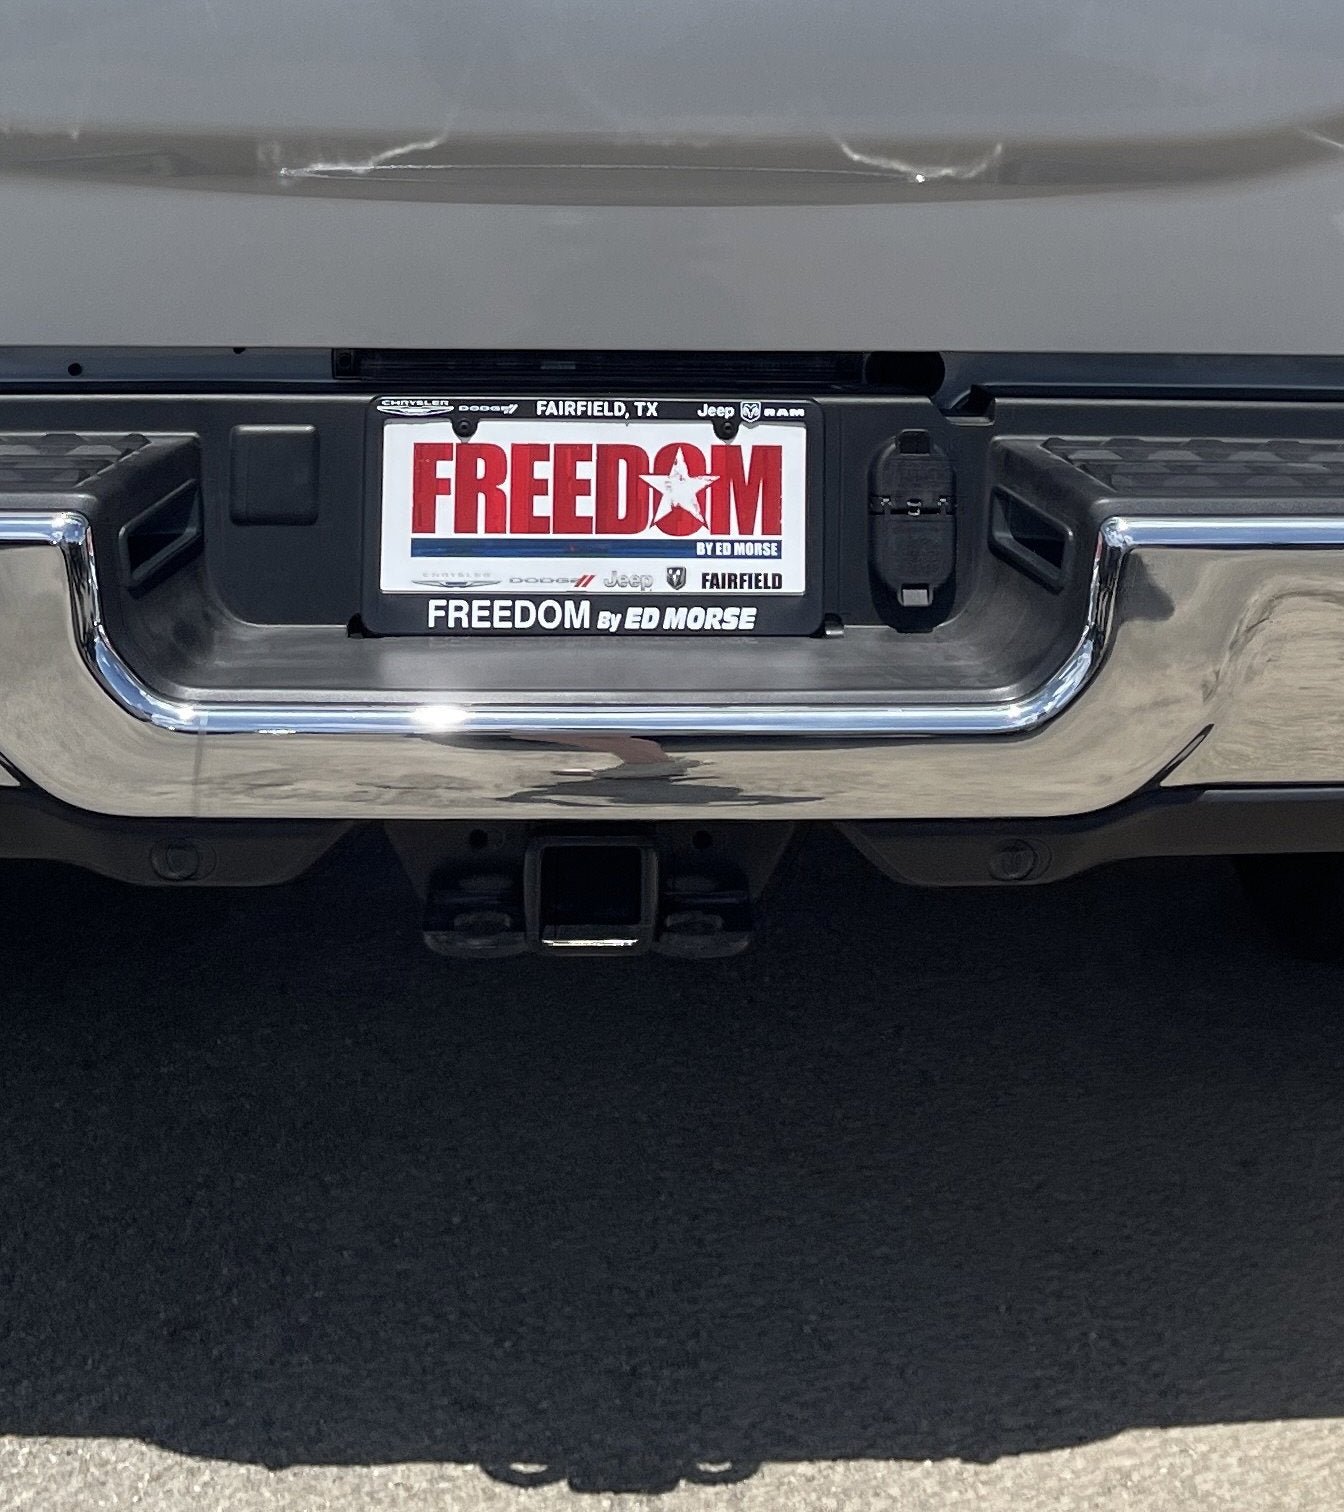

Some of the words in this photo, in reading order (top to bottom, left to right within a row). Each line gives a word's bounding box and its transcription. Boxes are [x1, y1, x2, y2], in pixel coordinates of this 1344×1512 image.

[536, 400, 629, 419] FAIRFIELD,
[632, 401, 658, 418] TX
[697, 403, 735, 419] Jeep
[763, 408, 805, 417] RAM
[411, 442, 782, 536] FREEDOM
[696, 542, 714, 556] BY
[715, 542, 732, 556] ED
[733, 542, 778, 556] MORSE
[604, 570, 654, 591] Jeep
[701, 572, 783, 590] FAIRFIELD
[427, 599, 590, 630] FREEDOM
[596, 610, 622, 632] By
[624, 607, 660, 630] ED
[662, 606, 757, 631] MORSE
